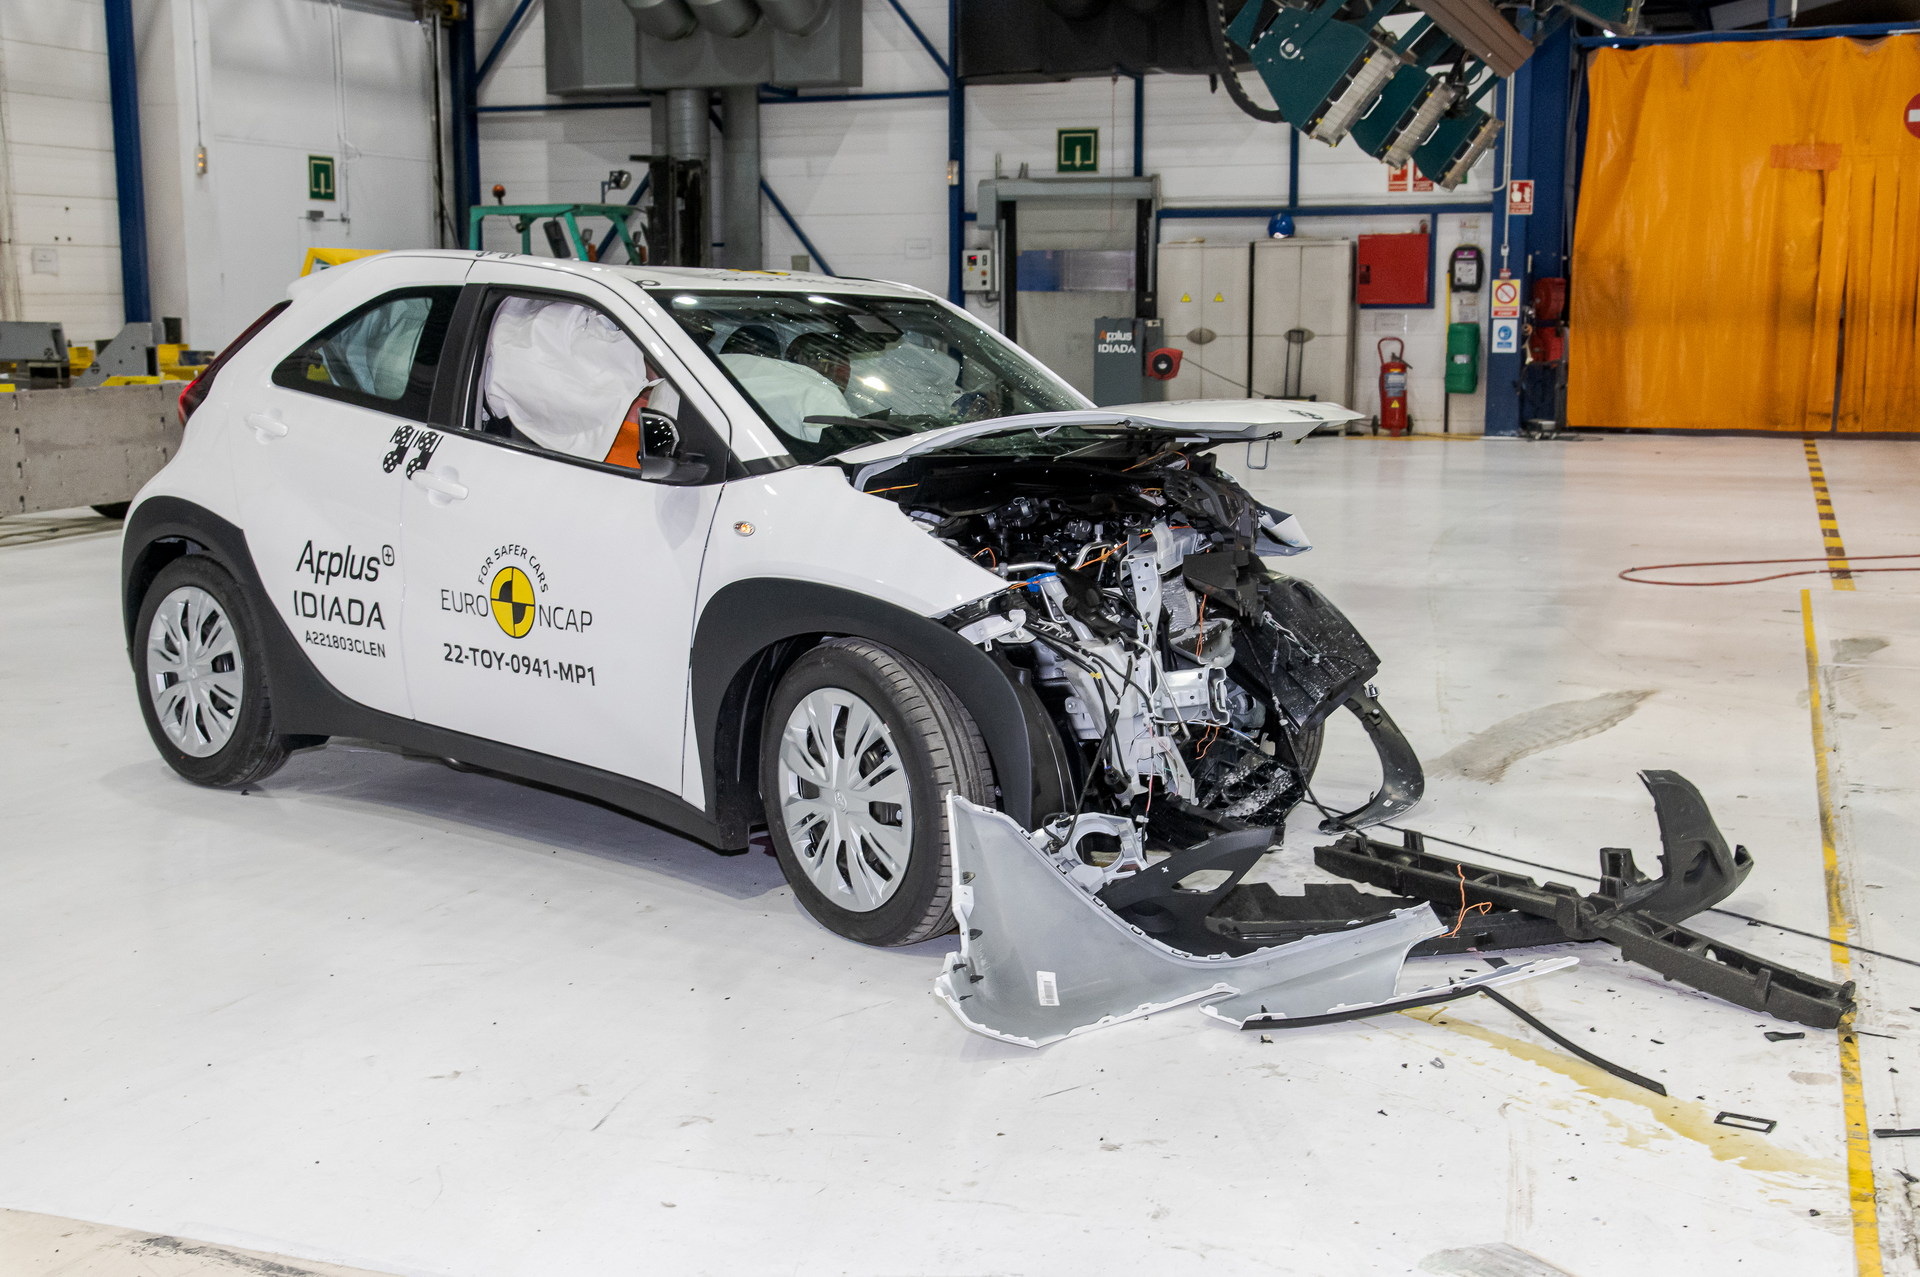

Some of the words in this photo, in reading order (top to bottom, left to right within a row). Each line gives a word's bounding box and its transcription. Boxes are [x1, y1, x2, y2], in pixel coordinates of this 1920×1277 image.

[1097, 343, 1136, 353] IDIADA
[478, 556, 494, 585] FOR
[494, 544, 528, 561] SAFER
[528, 555, 549, 593] CARS
[293, 590, 386, 630] IDIADA
[440, 588, 489, 617] EURO
[538, 604, 593, 633] NCAP
[305, 629, 386, 658] A221803CLEN
[443, 642, 596, 687] 22-TOY-0941-MP1
